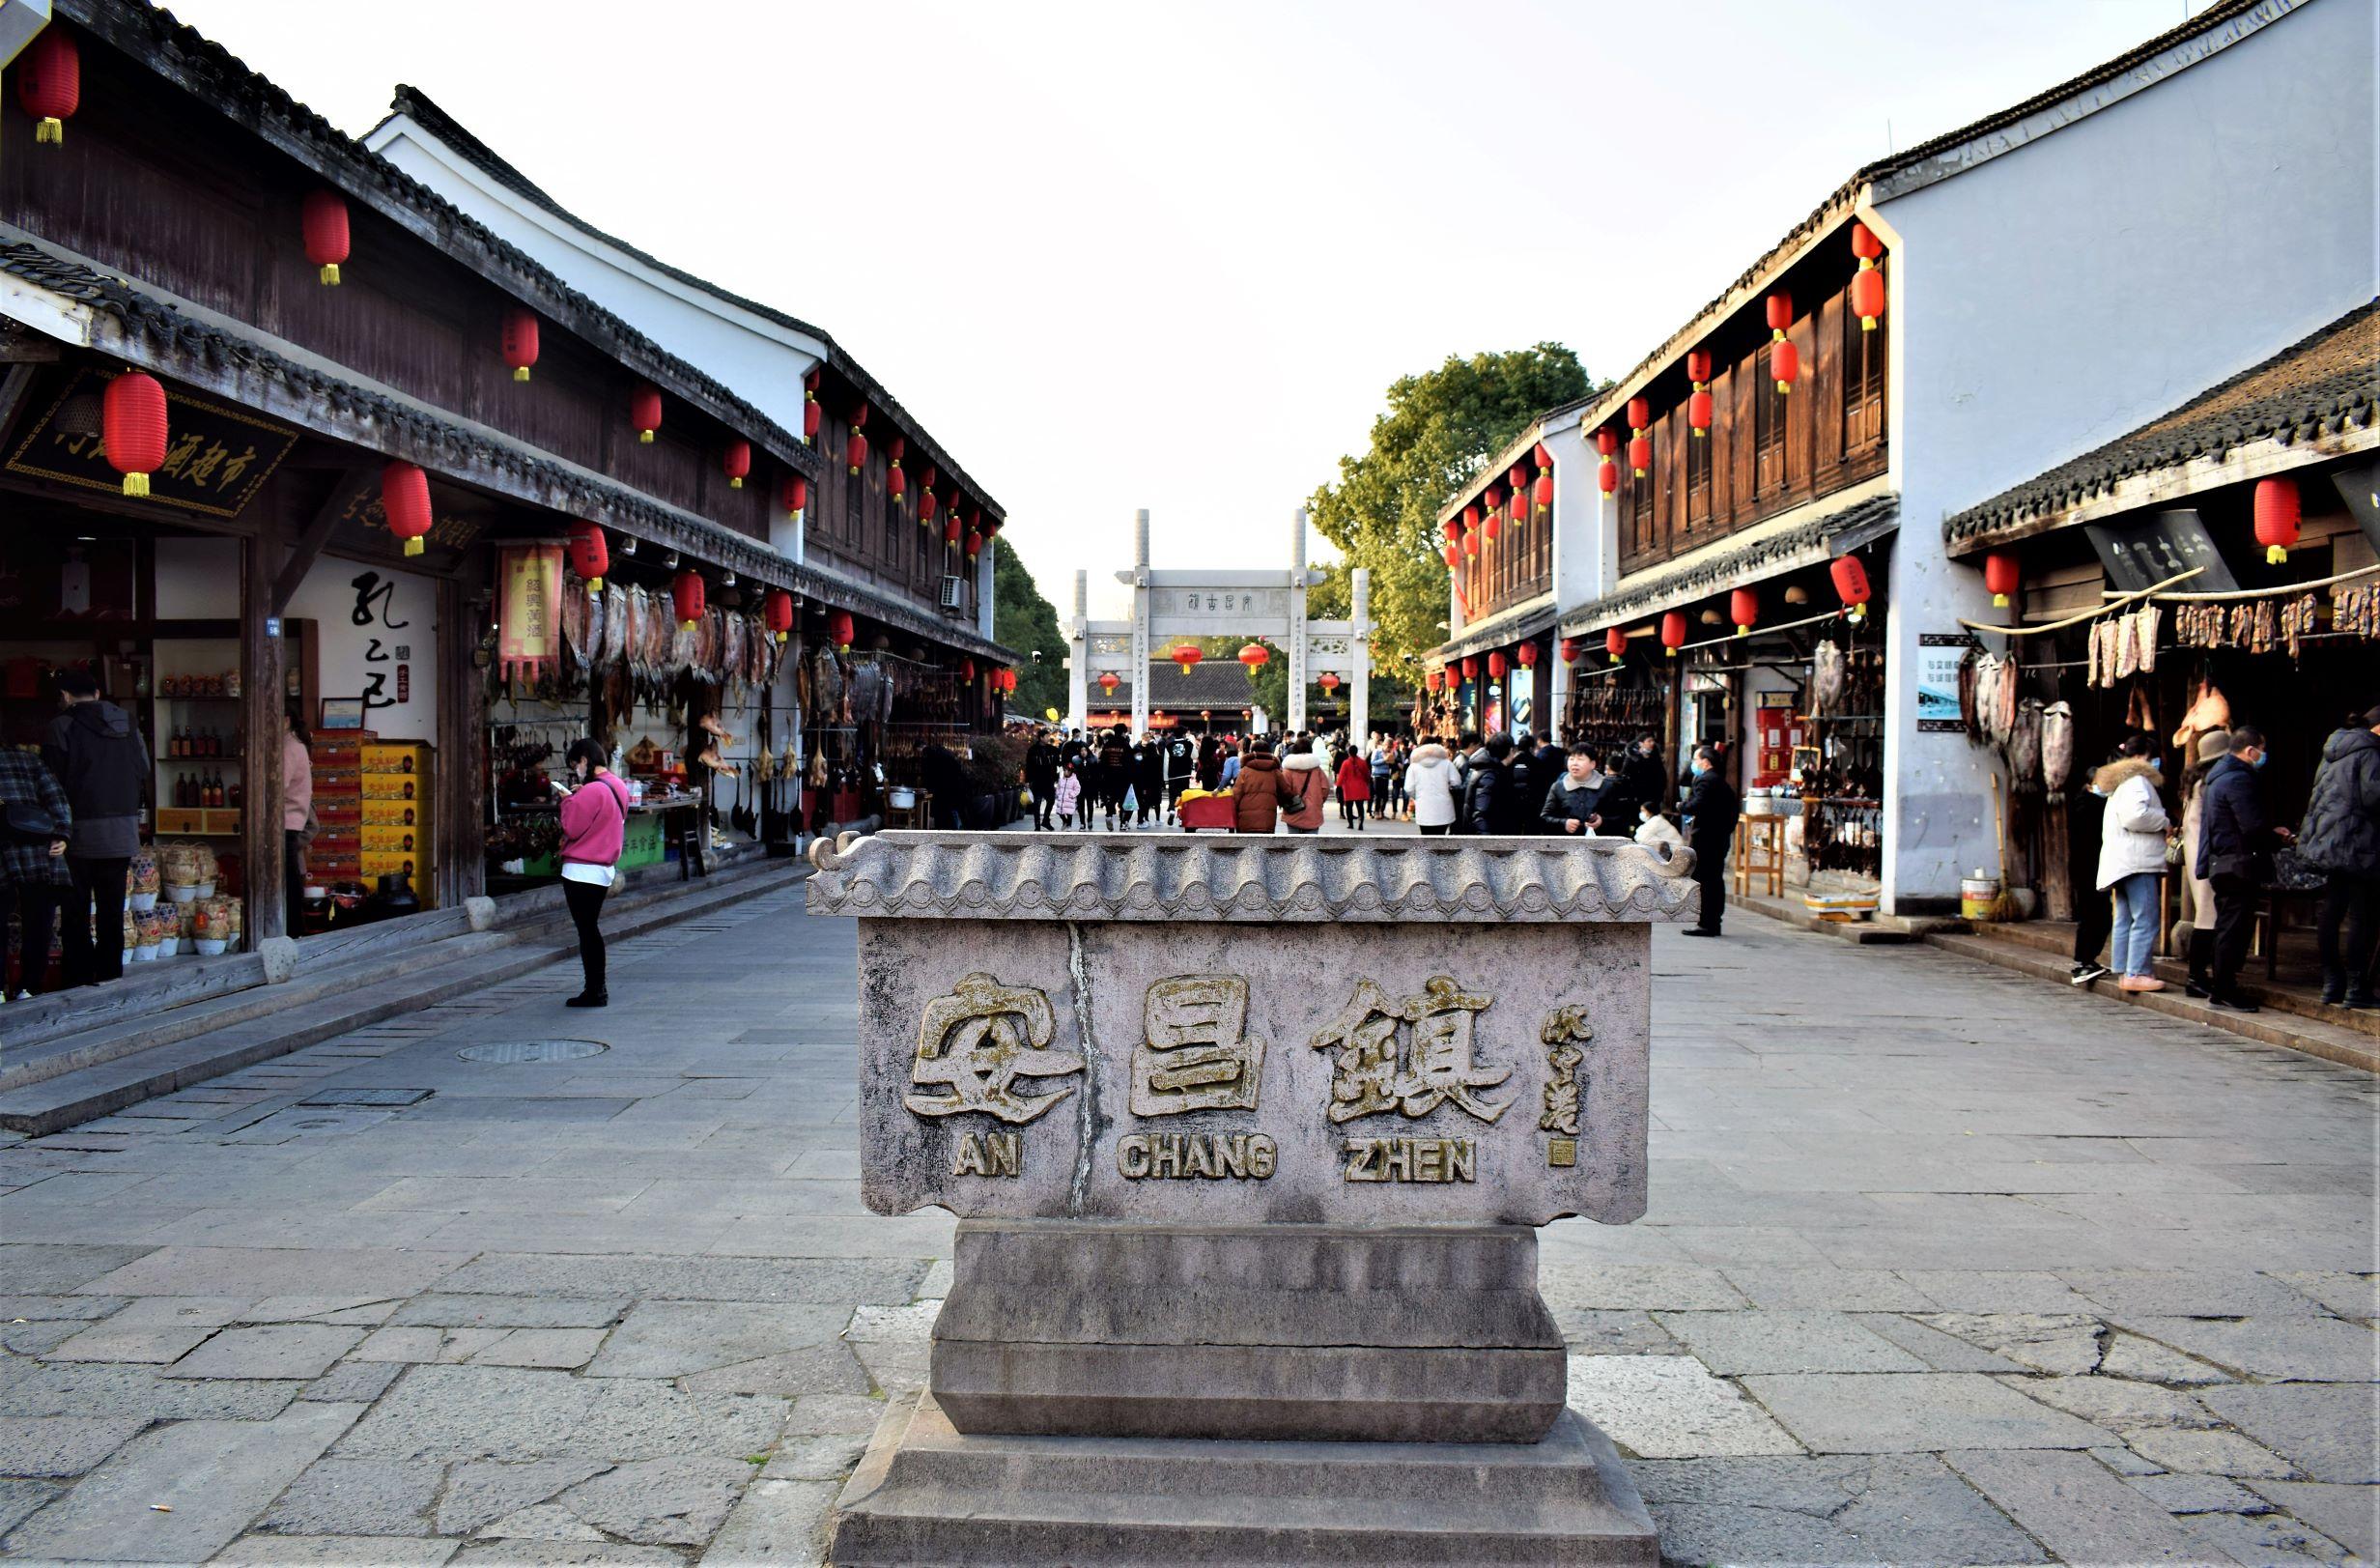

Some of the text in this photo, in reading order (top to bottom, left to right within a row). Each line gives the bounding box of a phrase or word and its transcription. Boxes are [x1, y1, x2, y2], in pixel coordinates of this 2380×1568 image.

[952, 1132, 1477, 1183] AN CHANG ZHEN
